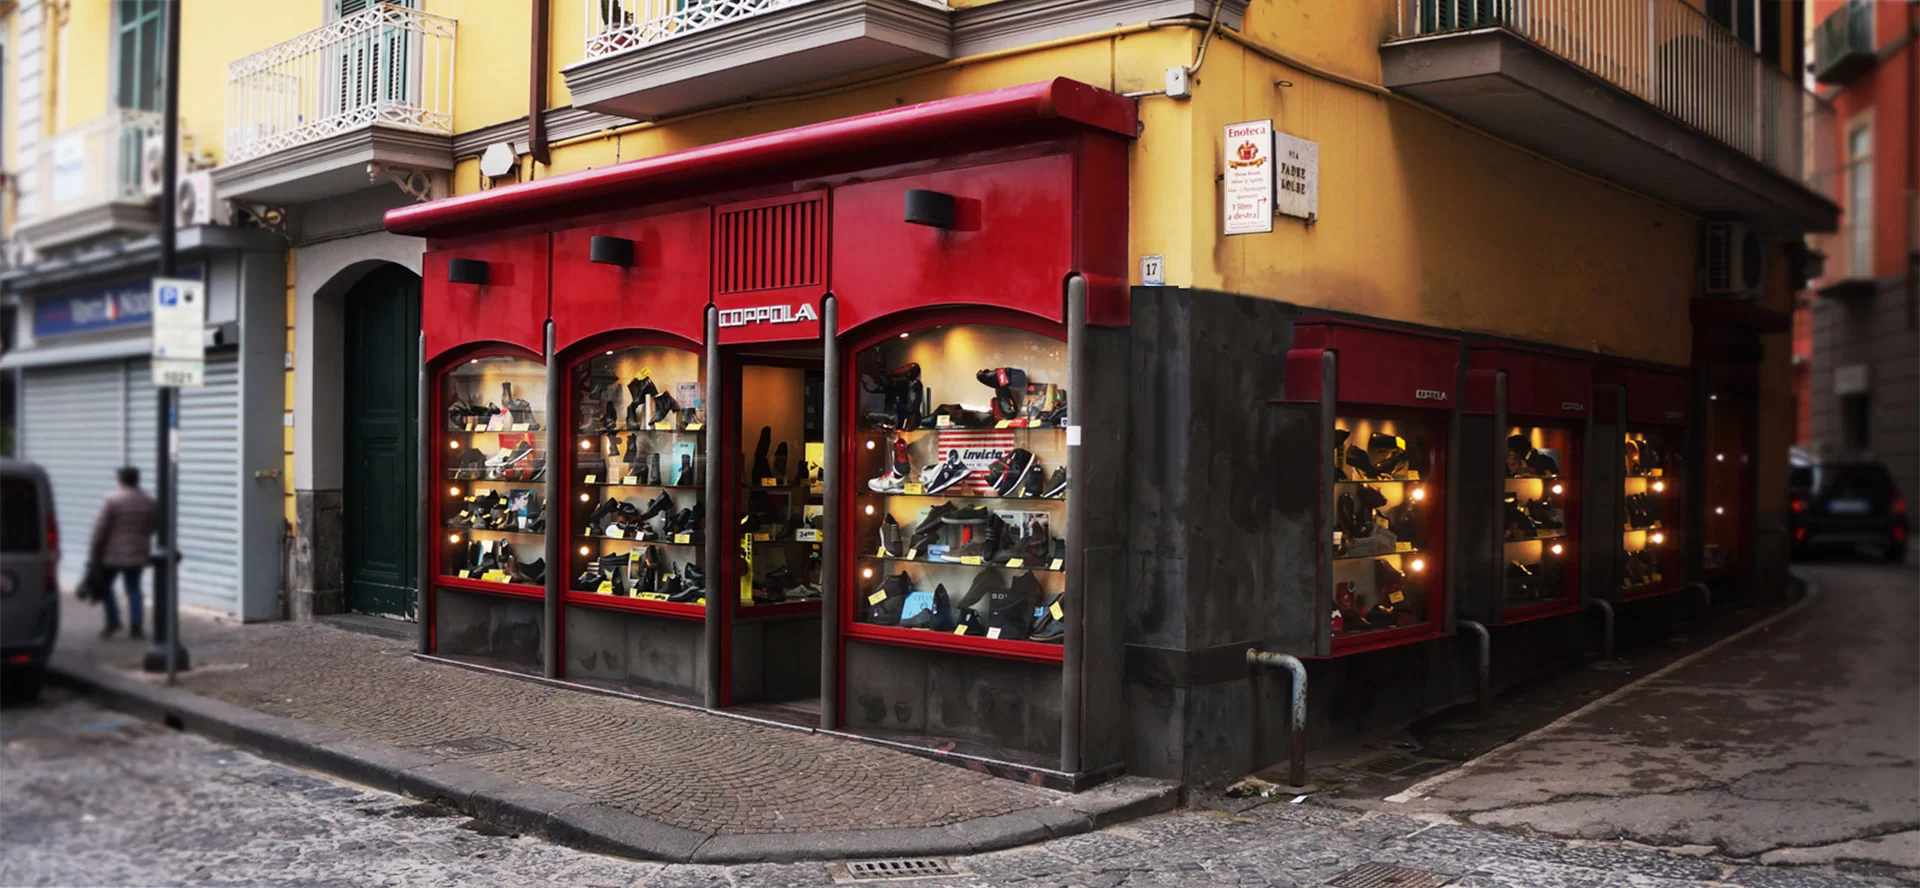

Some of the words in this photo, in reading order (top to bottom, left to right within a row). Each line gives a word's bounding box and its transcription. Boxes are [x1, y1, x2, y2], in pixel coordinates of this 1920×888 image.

[1228, 127, 1266, 138] Enoteca
[1288, 150, 1299, 160] VIA
[1234, 211, 1257, 220] destra
[1146, 262, 1158, 276] 17
[718, 303, 818, 328] COPPOLA
